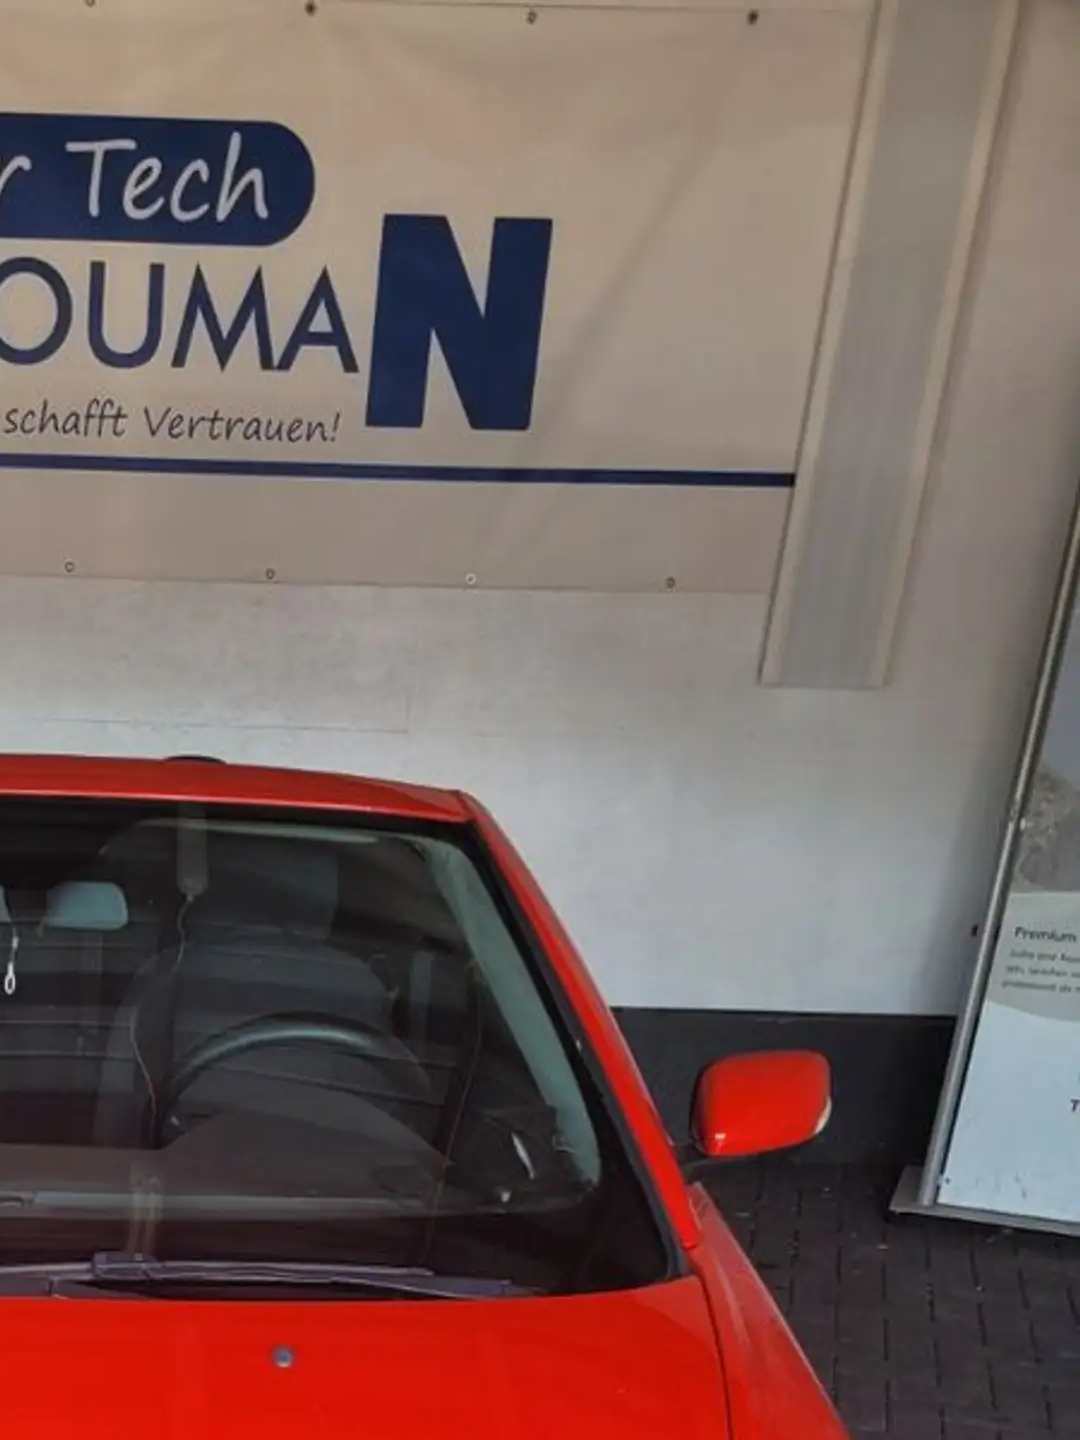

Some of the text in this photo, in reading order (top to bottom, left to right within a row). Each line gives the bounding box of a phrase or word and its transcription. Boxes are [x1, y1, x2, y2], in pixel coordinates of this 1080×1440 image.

[65, 131, 268, 222] Tech
[3, 398, 128, 438] schafft
[143, 404, 341, 443] Vertrauen!
[1014, 925, 1077, 943] Premium
